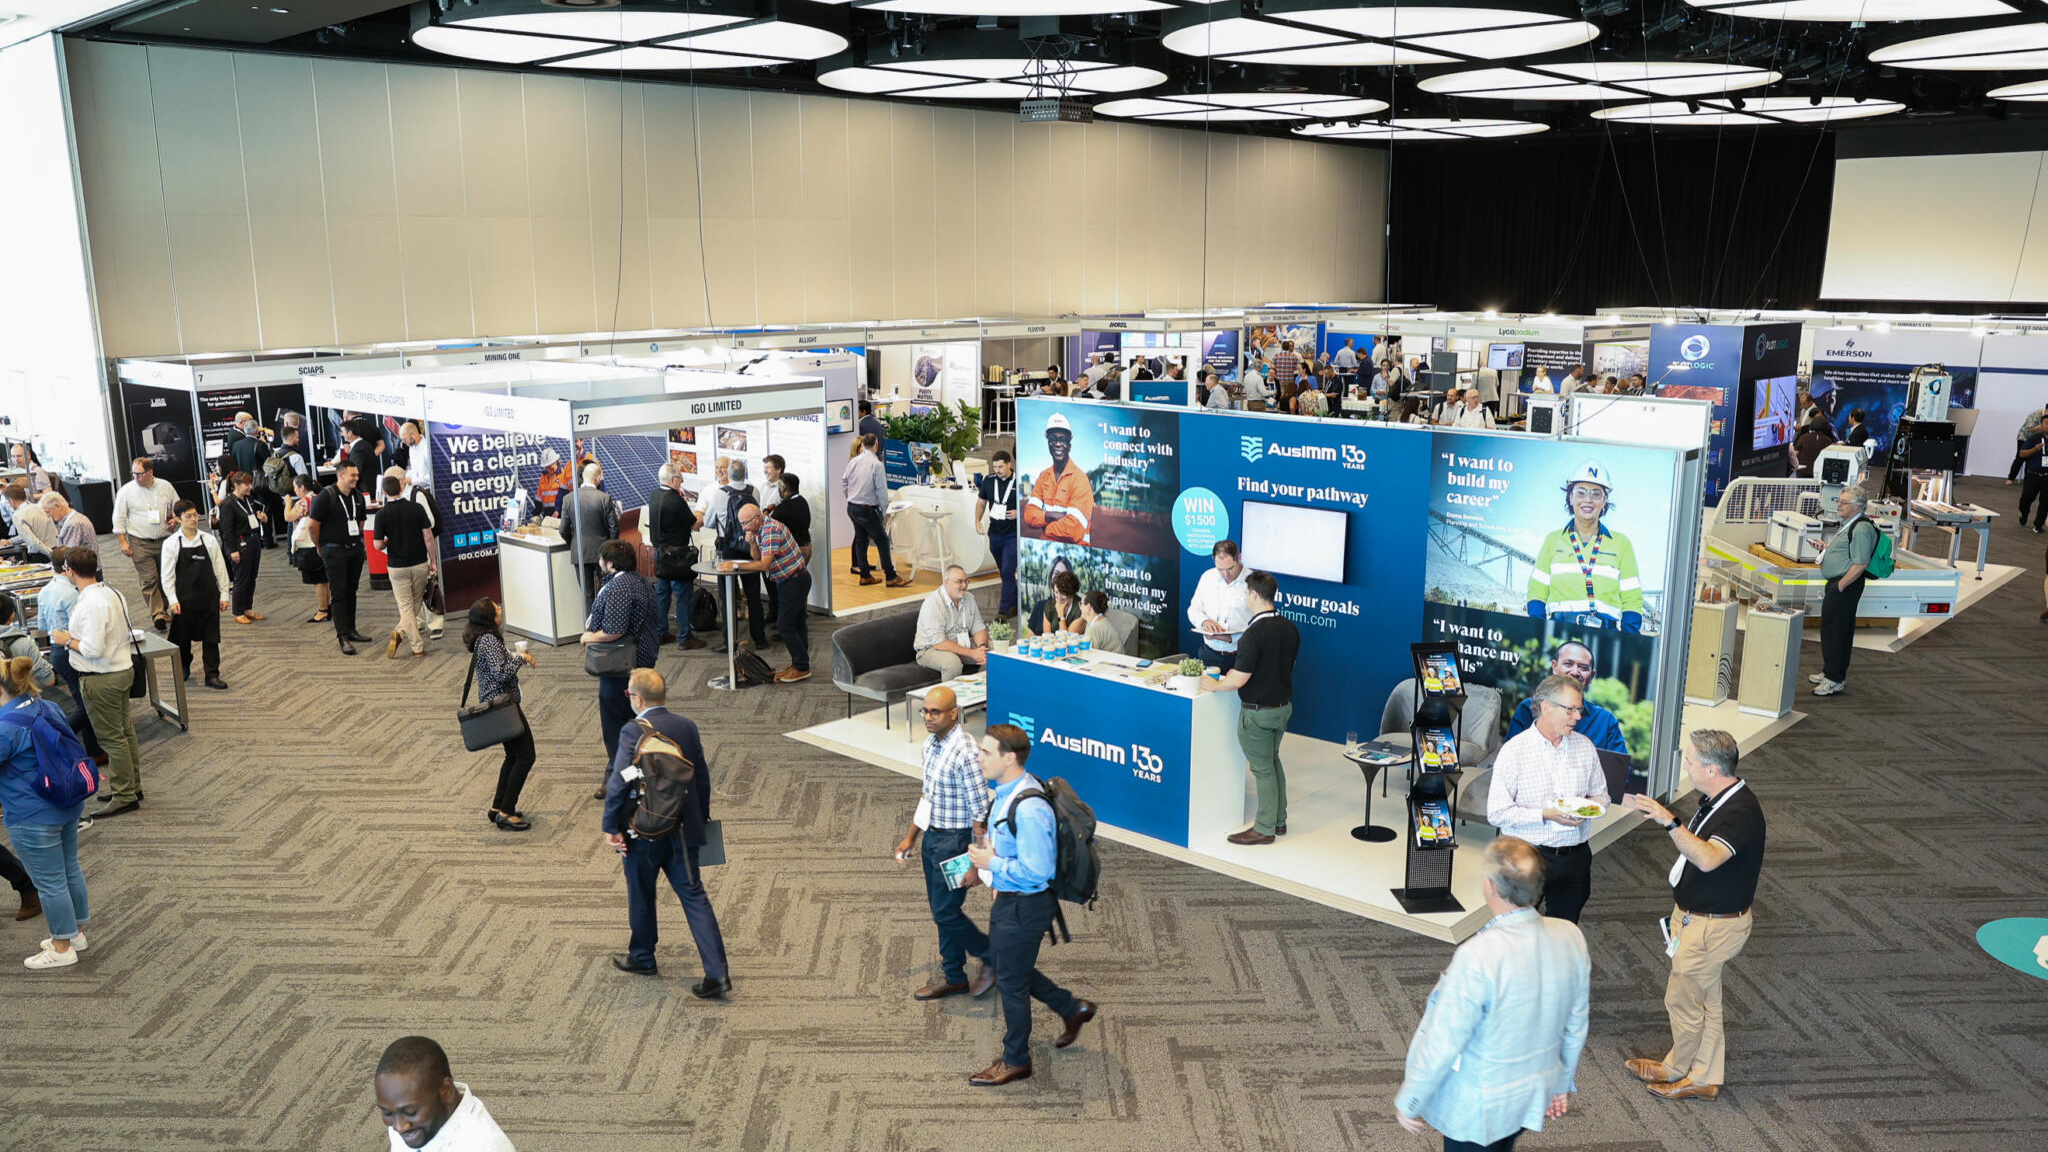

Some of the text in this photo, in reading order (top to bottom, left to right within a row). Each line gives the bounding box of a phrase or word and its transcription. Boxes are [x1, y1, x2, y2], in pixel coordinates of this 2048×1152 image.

[798, 336, 818, 344] ALLIGHT
[1498, 327, 1541, 337] Lycopodium
[484, 352, 521, 362] MINING ONE
[1826, 349, 1873, 358] EMERSON
[298, 365, 325, 375] SCIAPS
[406, 359, 412, 367] 8
[198, 374, 204, 382] 7
[691, 398, 743, 415] IGO LIMITED
[577, 414, 590, 426] 27
[1110, 425, 1138, 438] want
[1139, 425, 1152, 439] to
[446, 431, 547, 455] We believe
[1103, 440, 1174, 457] connect with
[1341, 444, 1367, 464] 130
[450, 451, 539, 475] in a clean
[1342, 461, 1366, 471] YEARS
[1458, 456, 1496, 472] want
[1498, 458, 1515, 473] to
[450, 474, 516, 495] energy
[1447, 470, 1511, 494] build my
[1237, 476, 1369, 509] Find your pathway
[452, 494, 510, 517] future
[1183, 497, 1215, 513] WIN
[1184, 514, 1216, 526] $1500
[458, 548, 500, 561] IGO.COM.A
[1112, 566, 1139, 580] want
[1140, 568, 1153, 582] to
[1104, 577, 1168, 602] broaden my
[1284, 591, 1319, 608] your
[1320, 598, 1361, 617] goals
[1276, 606, 1337, 629] imm.com
[1448, 622, 1485, 640] want
[1487, 627, 1503, 642] to
[1440, 639, 1497, 660] hance
[1499, 648, 1522, 666] my
[1131, 743, 1164, 774] 130
[1132, 768, 1162, 784] YEARS
